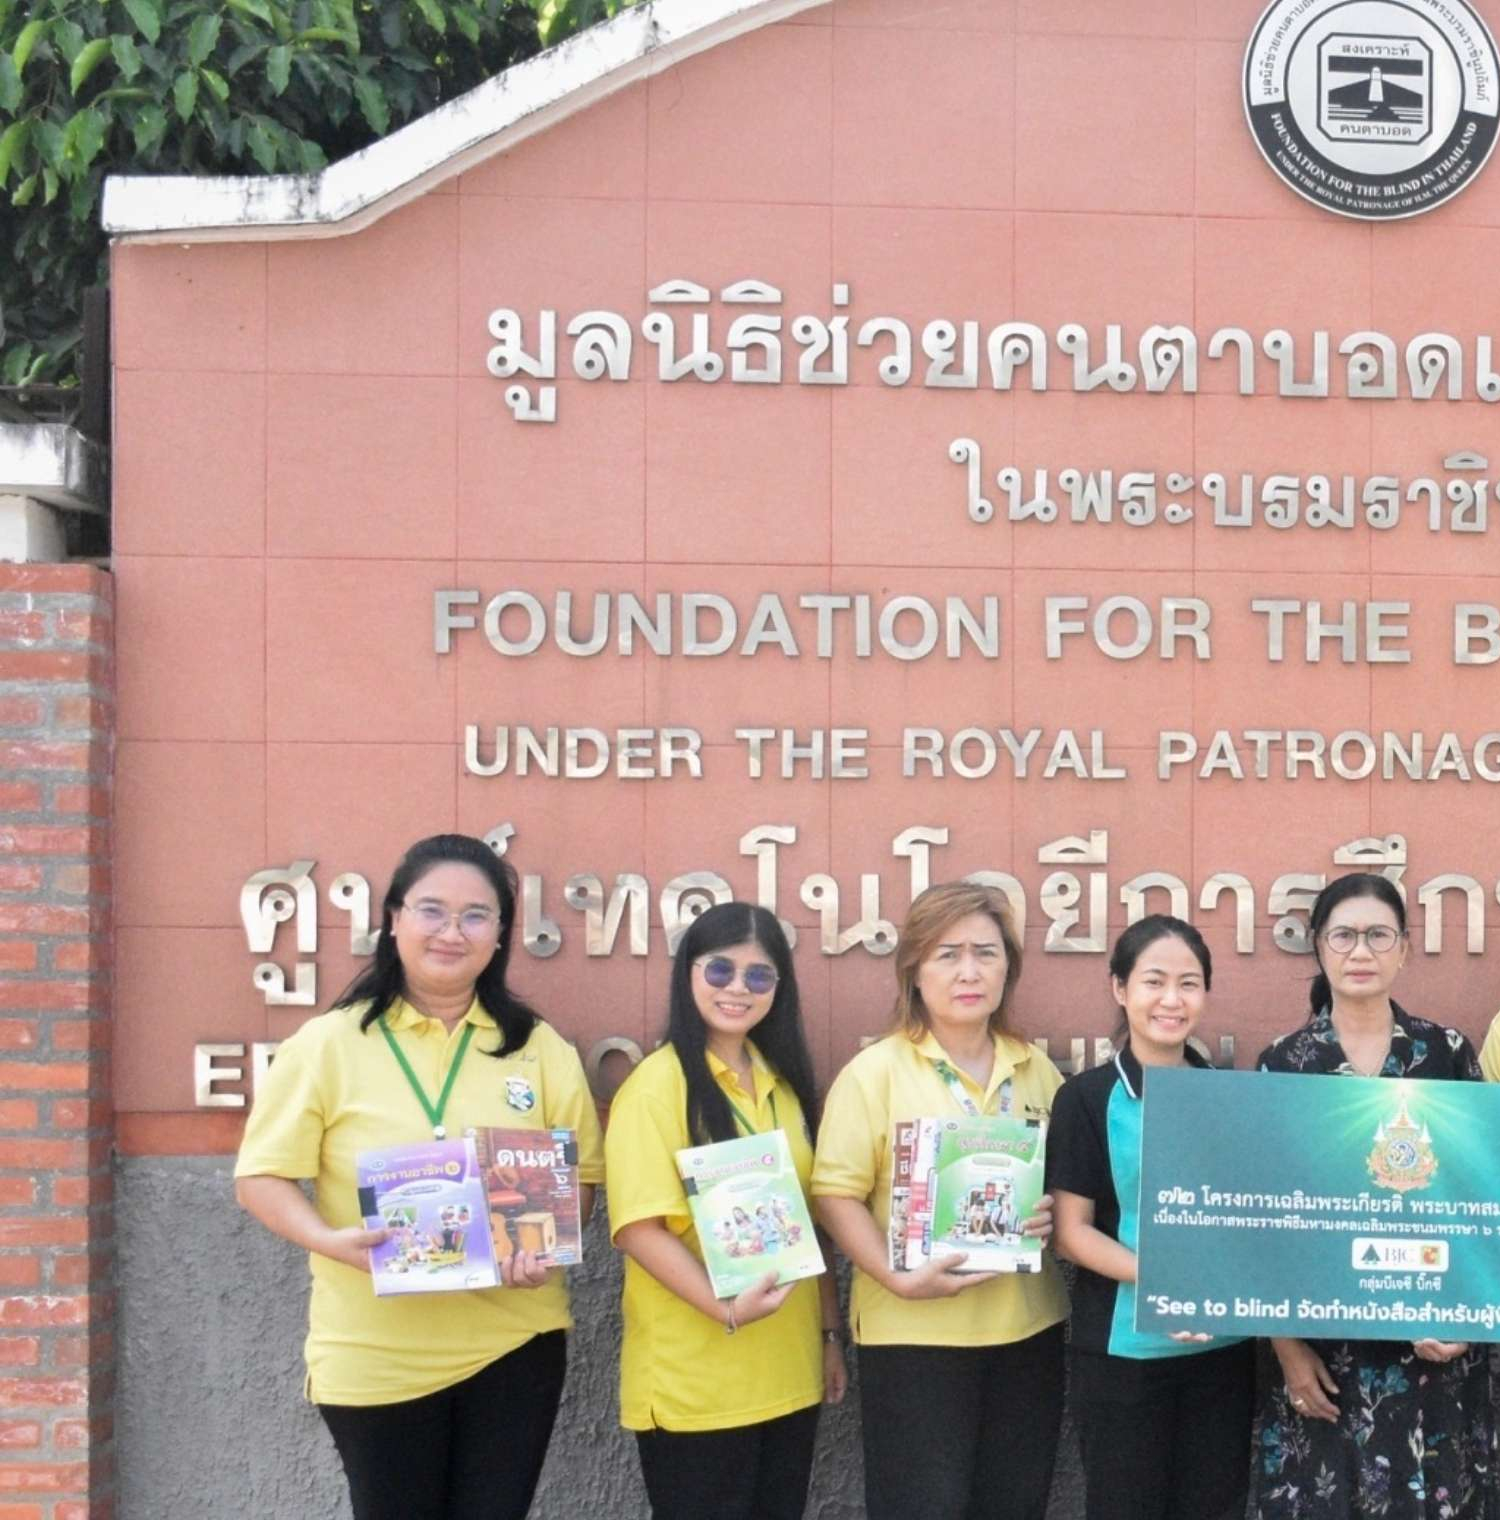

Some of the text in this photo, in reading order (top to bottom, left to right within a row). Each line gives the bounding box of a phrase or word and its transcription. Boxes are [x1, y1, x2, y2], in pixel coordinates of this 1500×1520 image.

[1340, 123, 1411, 137] คนตาบอด
[1271, 113, 1477, 197] FOUNDATION FOR THE BLIND IN THAILAND
[432, 590, 1000, 662] FOUNDATION
[1044, 595, 1212, 661] FOR
[1251, 599, 1411, 664] THE
[464, 725, 703, 779] UNDER
[735, 729, 869, 780] THE
[903, 728, 1127, 780] ROYAL
[1201, 1185, 1403, 1214] โครงการเฉลิมพระเกียรติ
[1359, 1274, 1412, 1294] กลุ่มบีเจซี
[1204, 1299, 1227, 1317] to
[1234, 1298, 1290, 1318] blind
